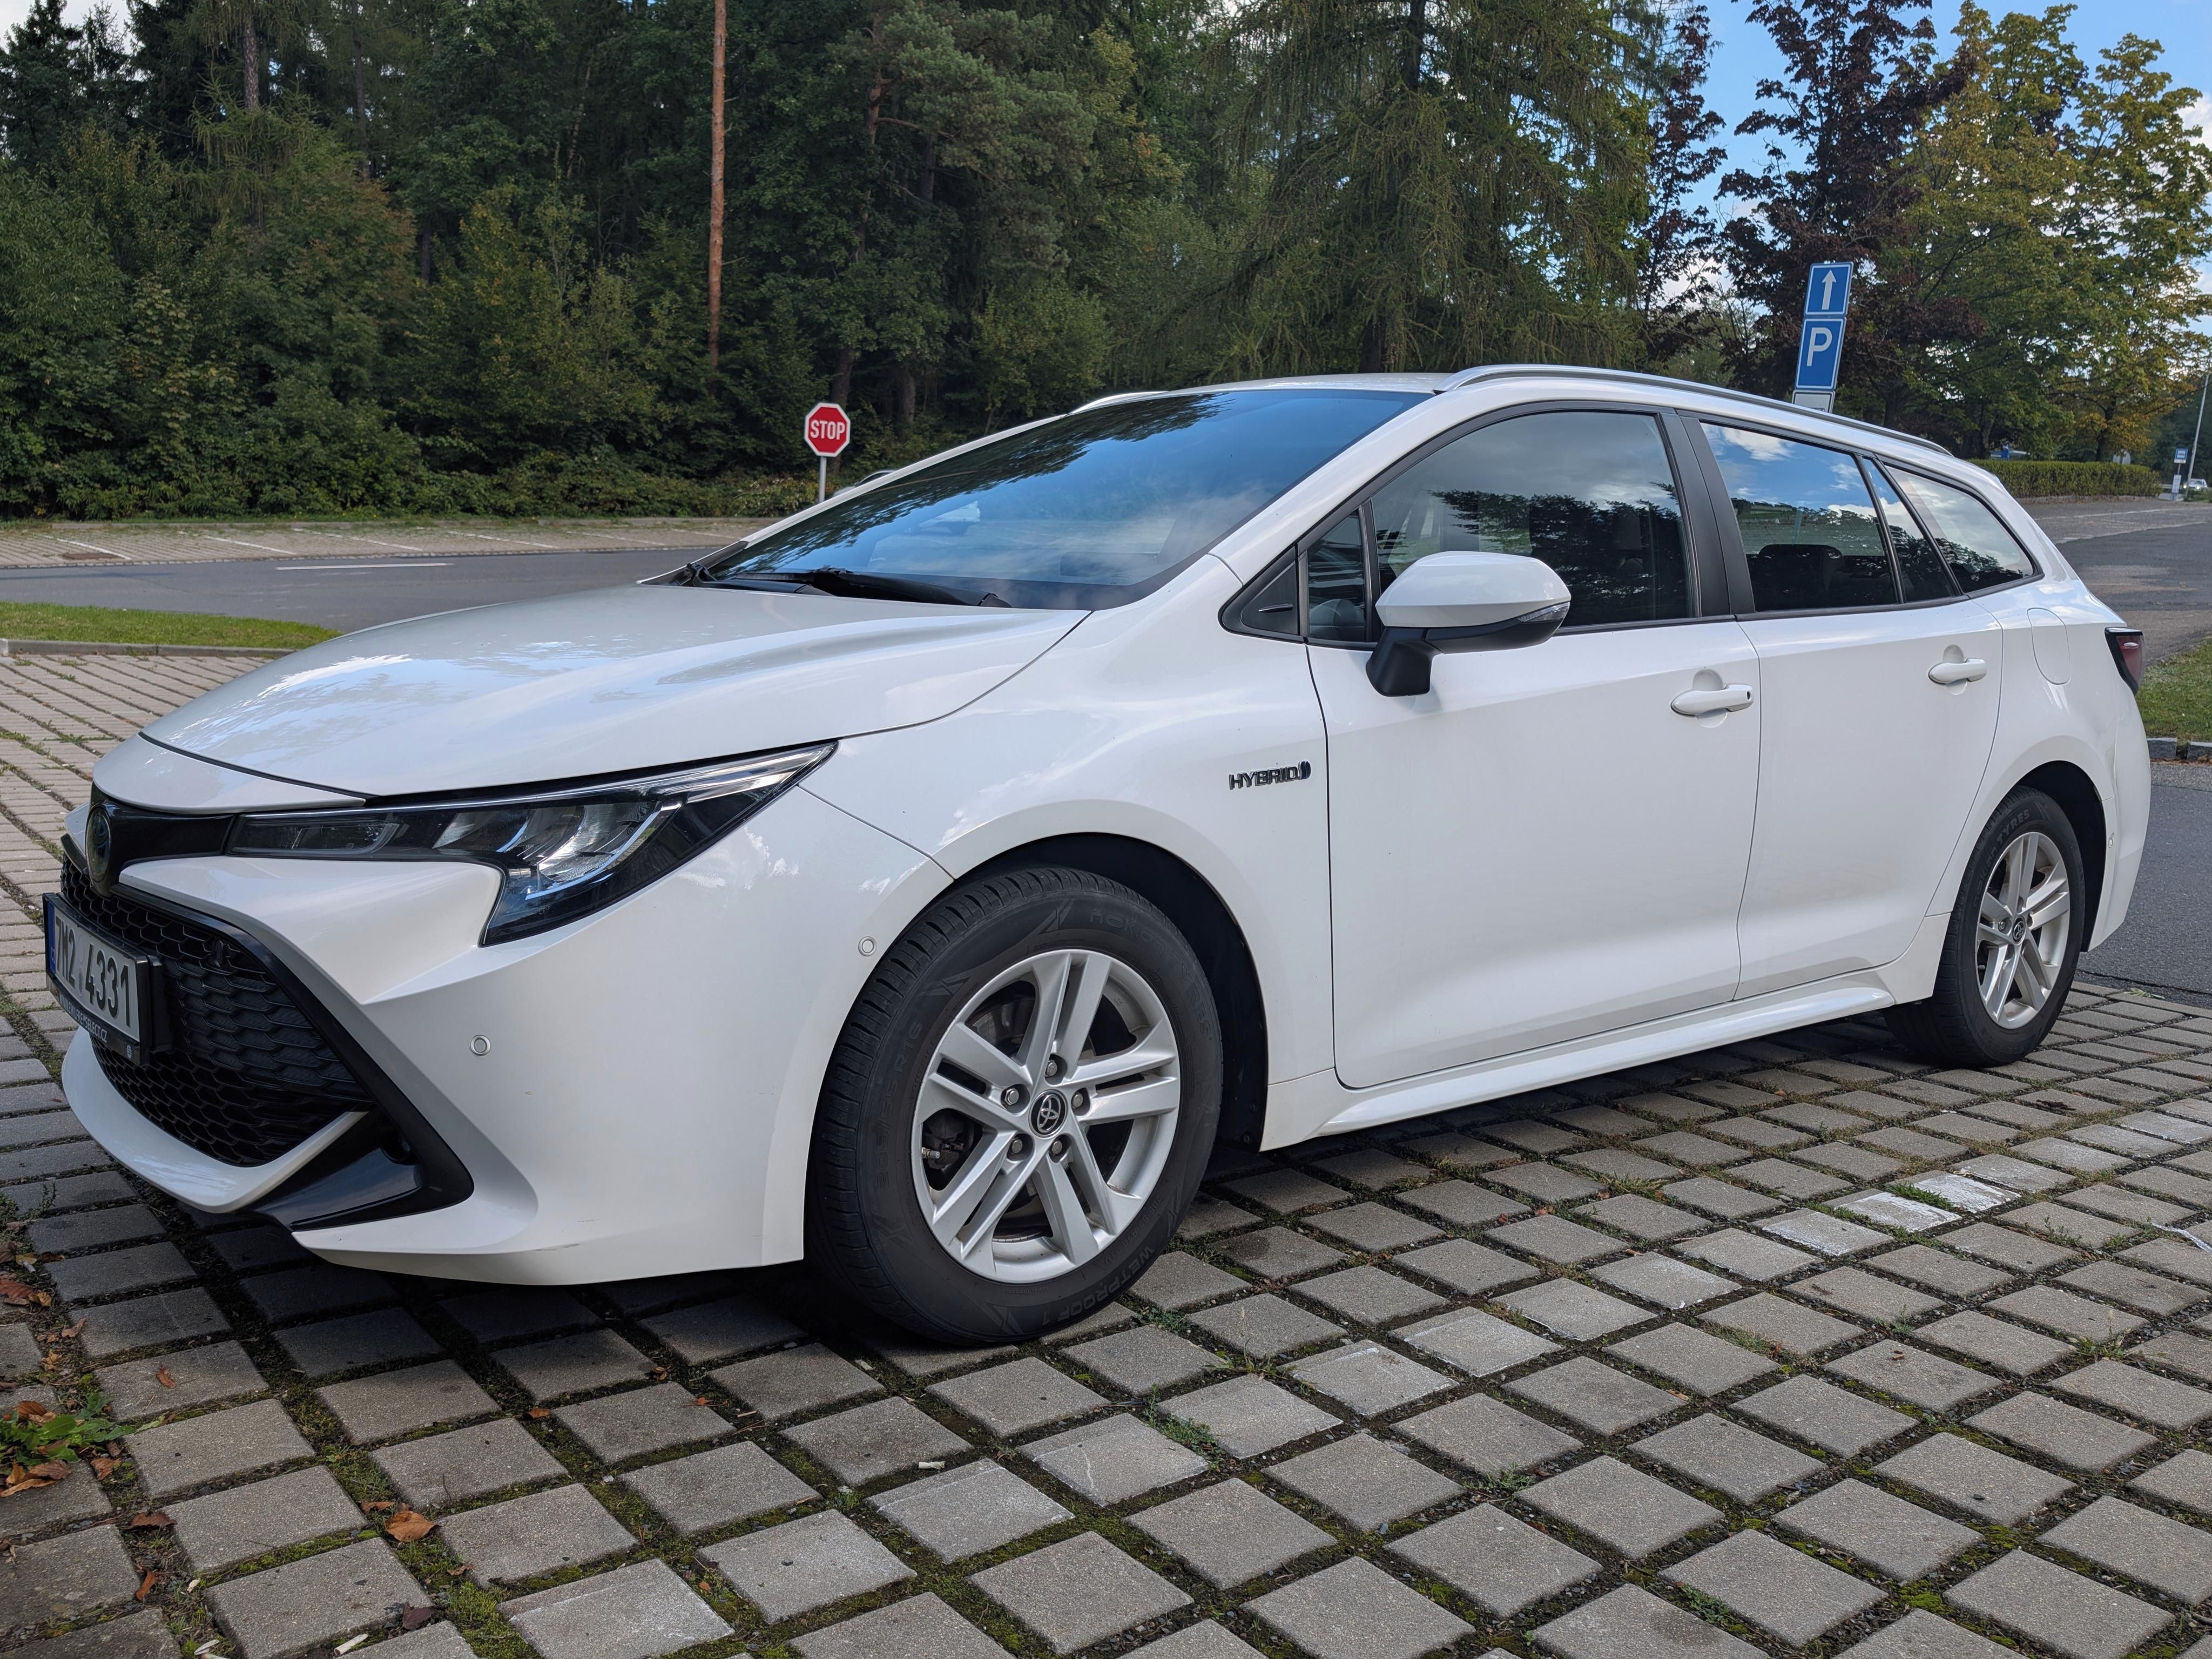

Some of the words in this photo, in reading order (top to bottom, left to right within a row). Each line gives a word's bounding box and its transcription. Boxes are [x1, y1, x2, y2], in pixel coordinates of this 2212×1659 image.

[1806, 327, 1832, 367] P
[810, 420, 845, 440] STOP
[1228, 765, 1298, 790] HYBRID
[1997, 809, 2030, 844] TYRES
[51, 946, 56, 964] CZ
[56, 915, 76, 989] 7M2
[85, 943, 131, 1028] 4331
[1167, 950, 1211, 1038] TYRES
[59, 993, 107, 1043] WWW.EMILFREYSELECT.CZ
[876, 1078, 899, 1189] 205/55
[893, 1021, 923, 1073] R16
[1138, 1195, 1163, 1230] 205/55
[1057, 1245, 1156, 1321] WETPROOF
